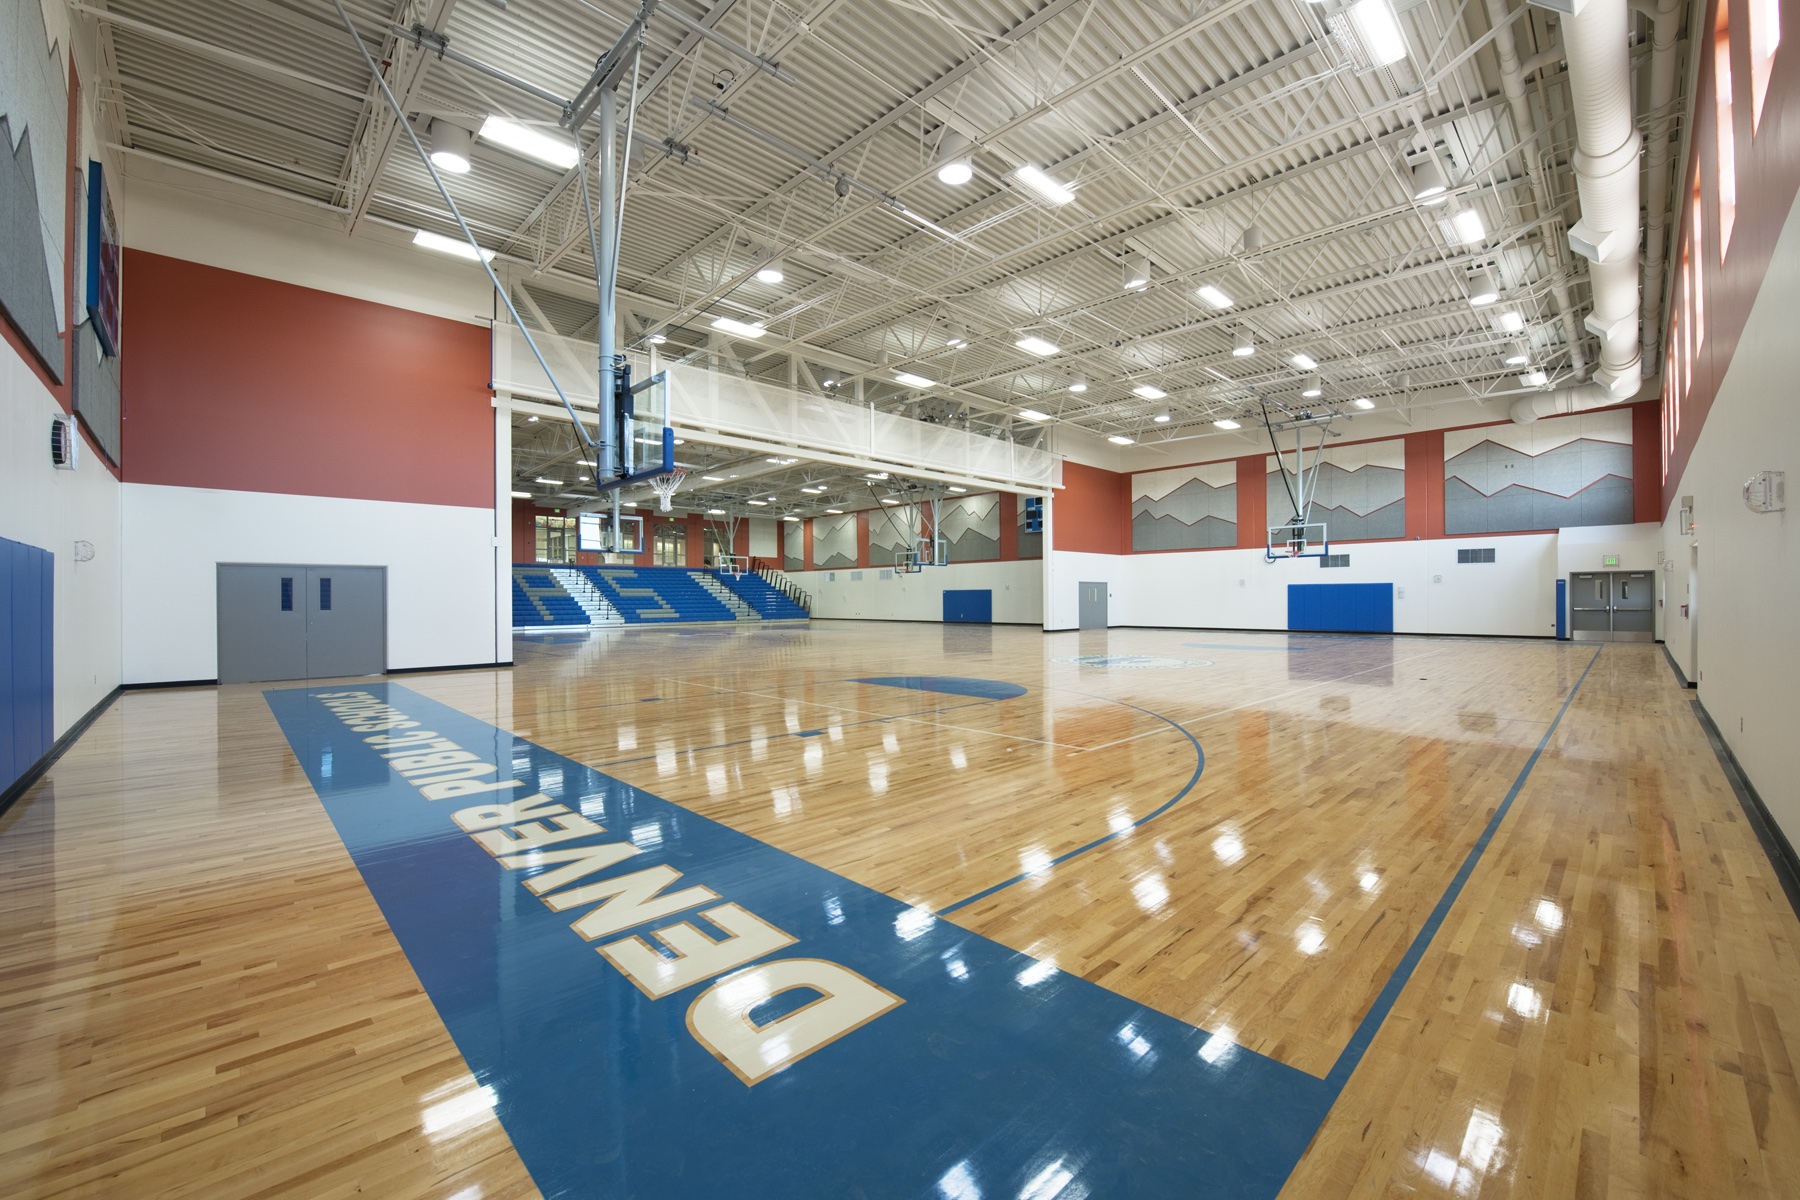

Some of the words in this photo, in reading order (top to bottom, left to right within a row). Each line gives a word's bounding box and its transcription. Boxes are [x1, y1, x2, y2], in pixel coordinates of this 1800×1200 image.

[315, 691, 421, 732] SCHOOLS
[362, 730, 526, 801] PUBLIC
[450, 792, 906, 1088] DENVER
